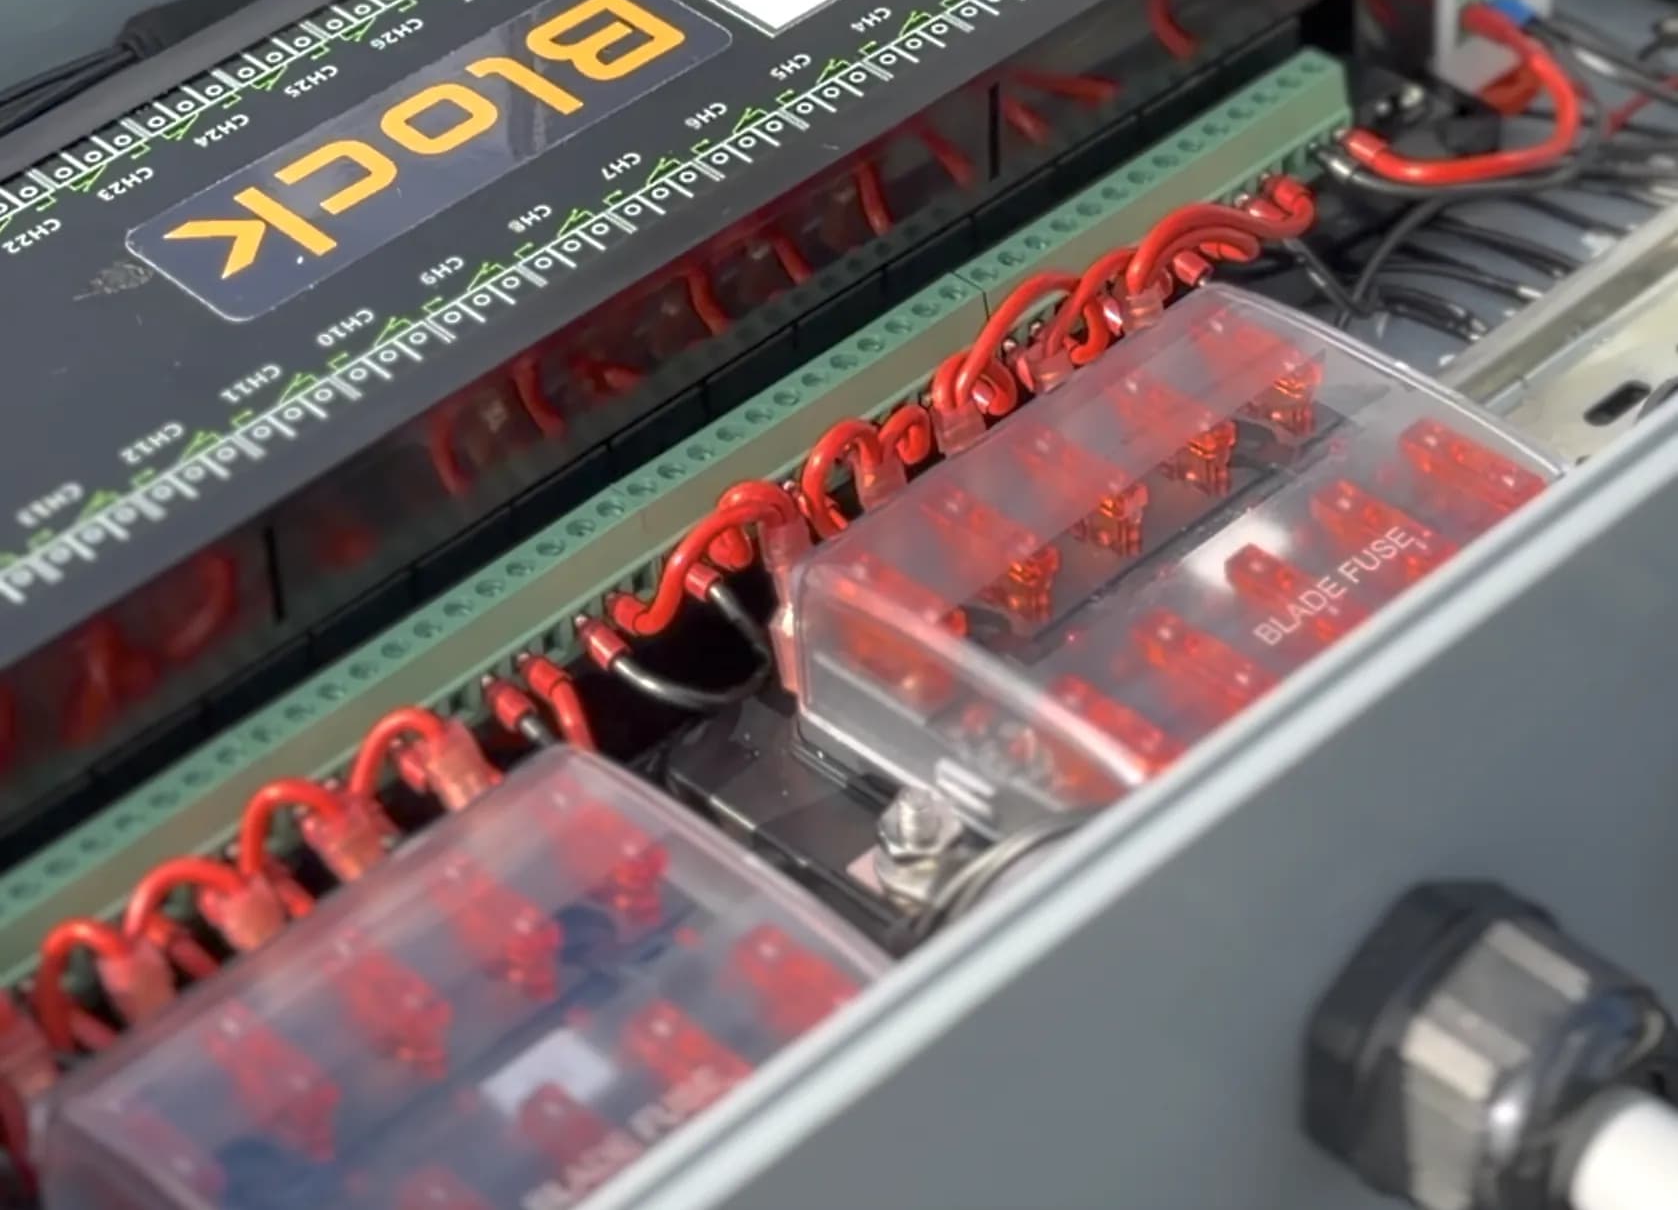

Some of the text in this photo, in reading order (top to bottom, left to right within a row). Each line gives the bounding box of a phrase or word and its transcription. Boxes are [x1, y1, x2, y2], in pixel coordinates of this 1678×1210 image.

[365, 16, 428, 51] CH26
[846, 5, 895, 34] CH4
[280, 63, 341, 98] CH25
[765, 51, 815, 81] CH5
[190, 112, 253, 148] CH24
[681, 100, 731, 130] CH6
[593, 149, 645, 181] CH7
[93, 165, 157, 202] CH23
[1, 216, 64, 254] CH22
[504, 202, 555, 233] CH8
[415, 254, 468, 287] CH9
[311, 306, 378, 348] CH10
[217, 362, 284, 404] CH11
[116, 419, 187, 465] CH12
[1251, 522, 1414, 649] BLADE FUSE
